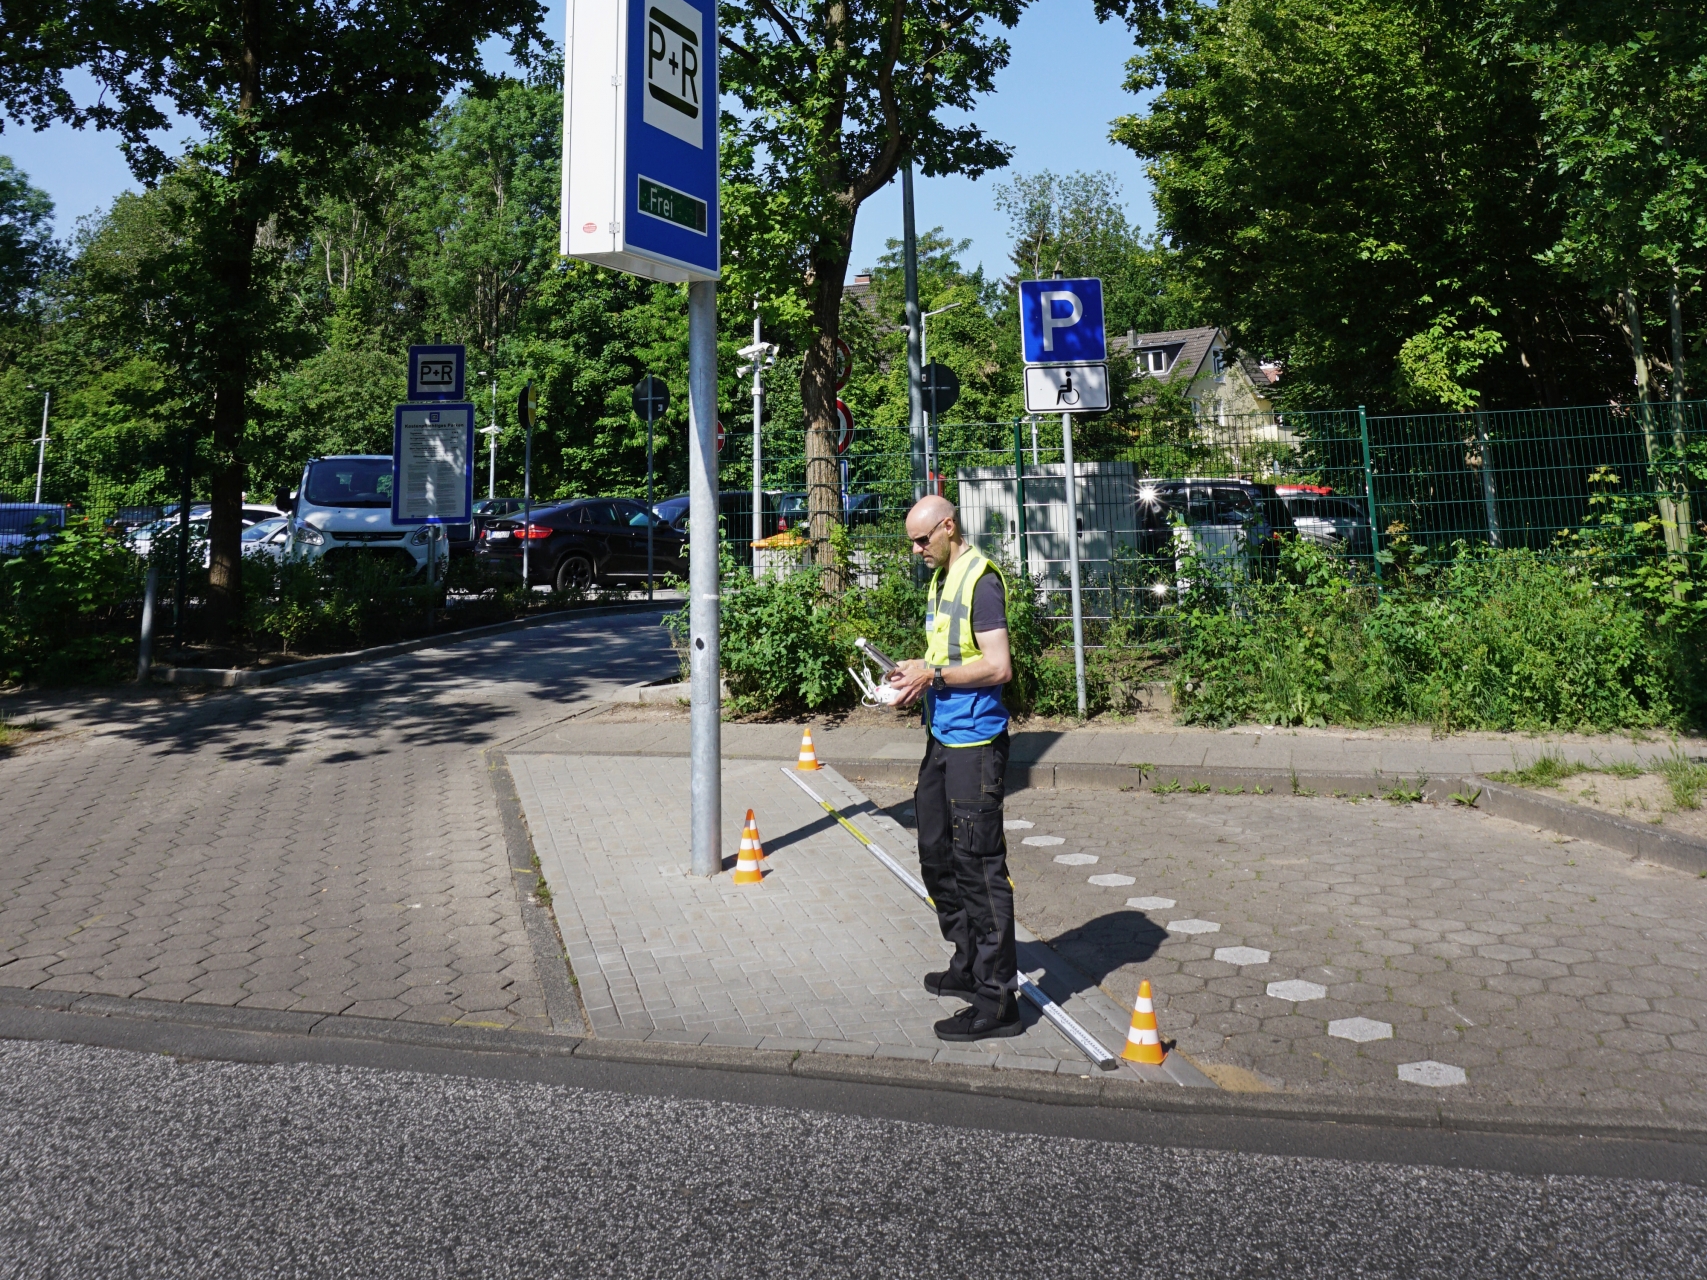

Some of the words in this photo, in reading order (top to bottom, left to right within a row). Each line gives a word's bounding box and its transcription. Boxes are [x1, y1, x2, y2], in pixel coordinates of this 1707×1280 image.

[648, 21, 699, 104] P+R
[650, 187, 673, 218] Frei
[1041, 291, 1083, 351] P
[420, 365, 453, 381] P+R
